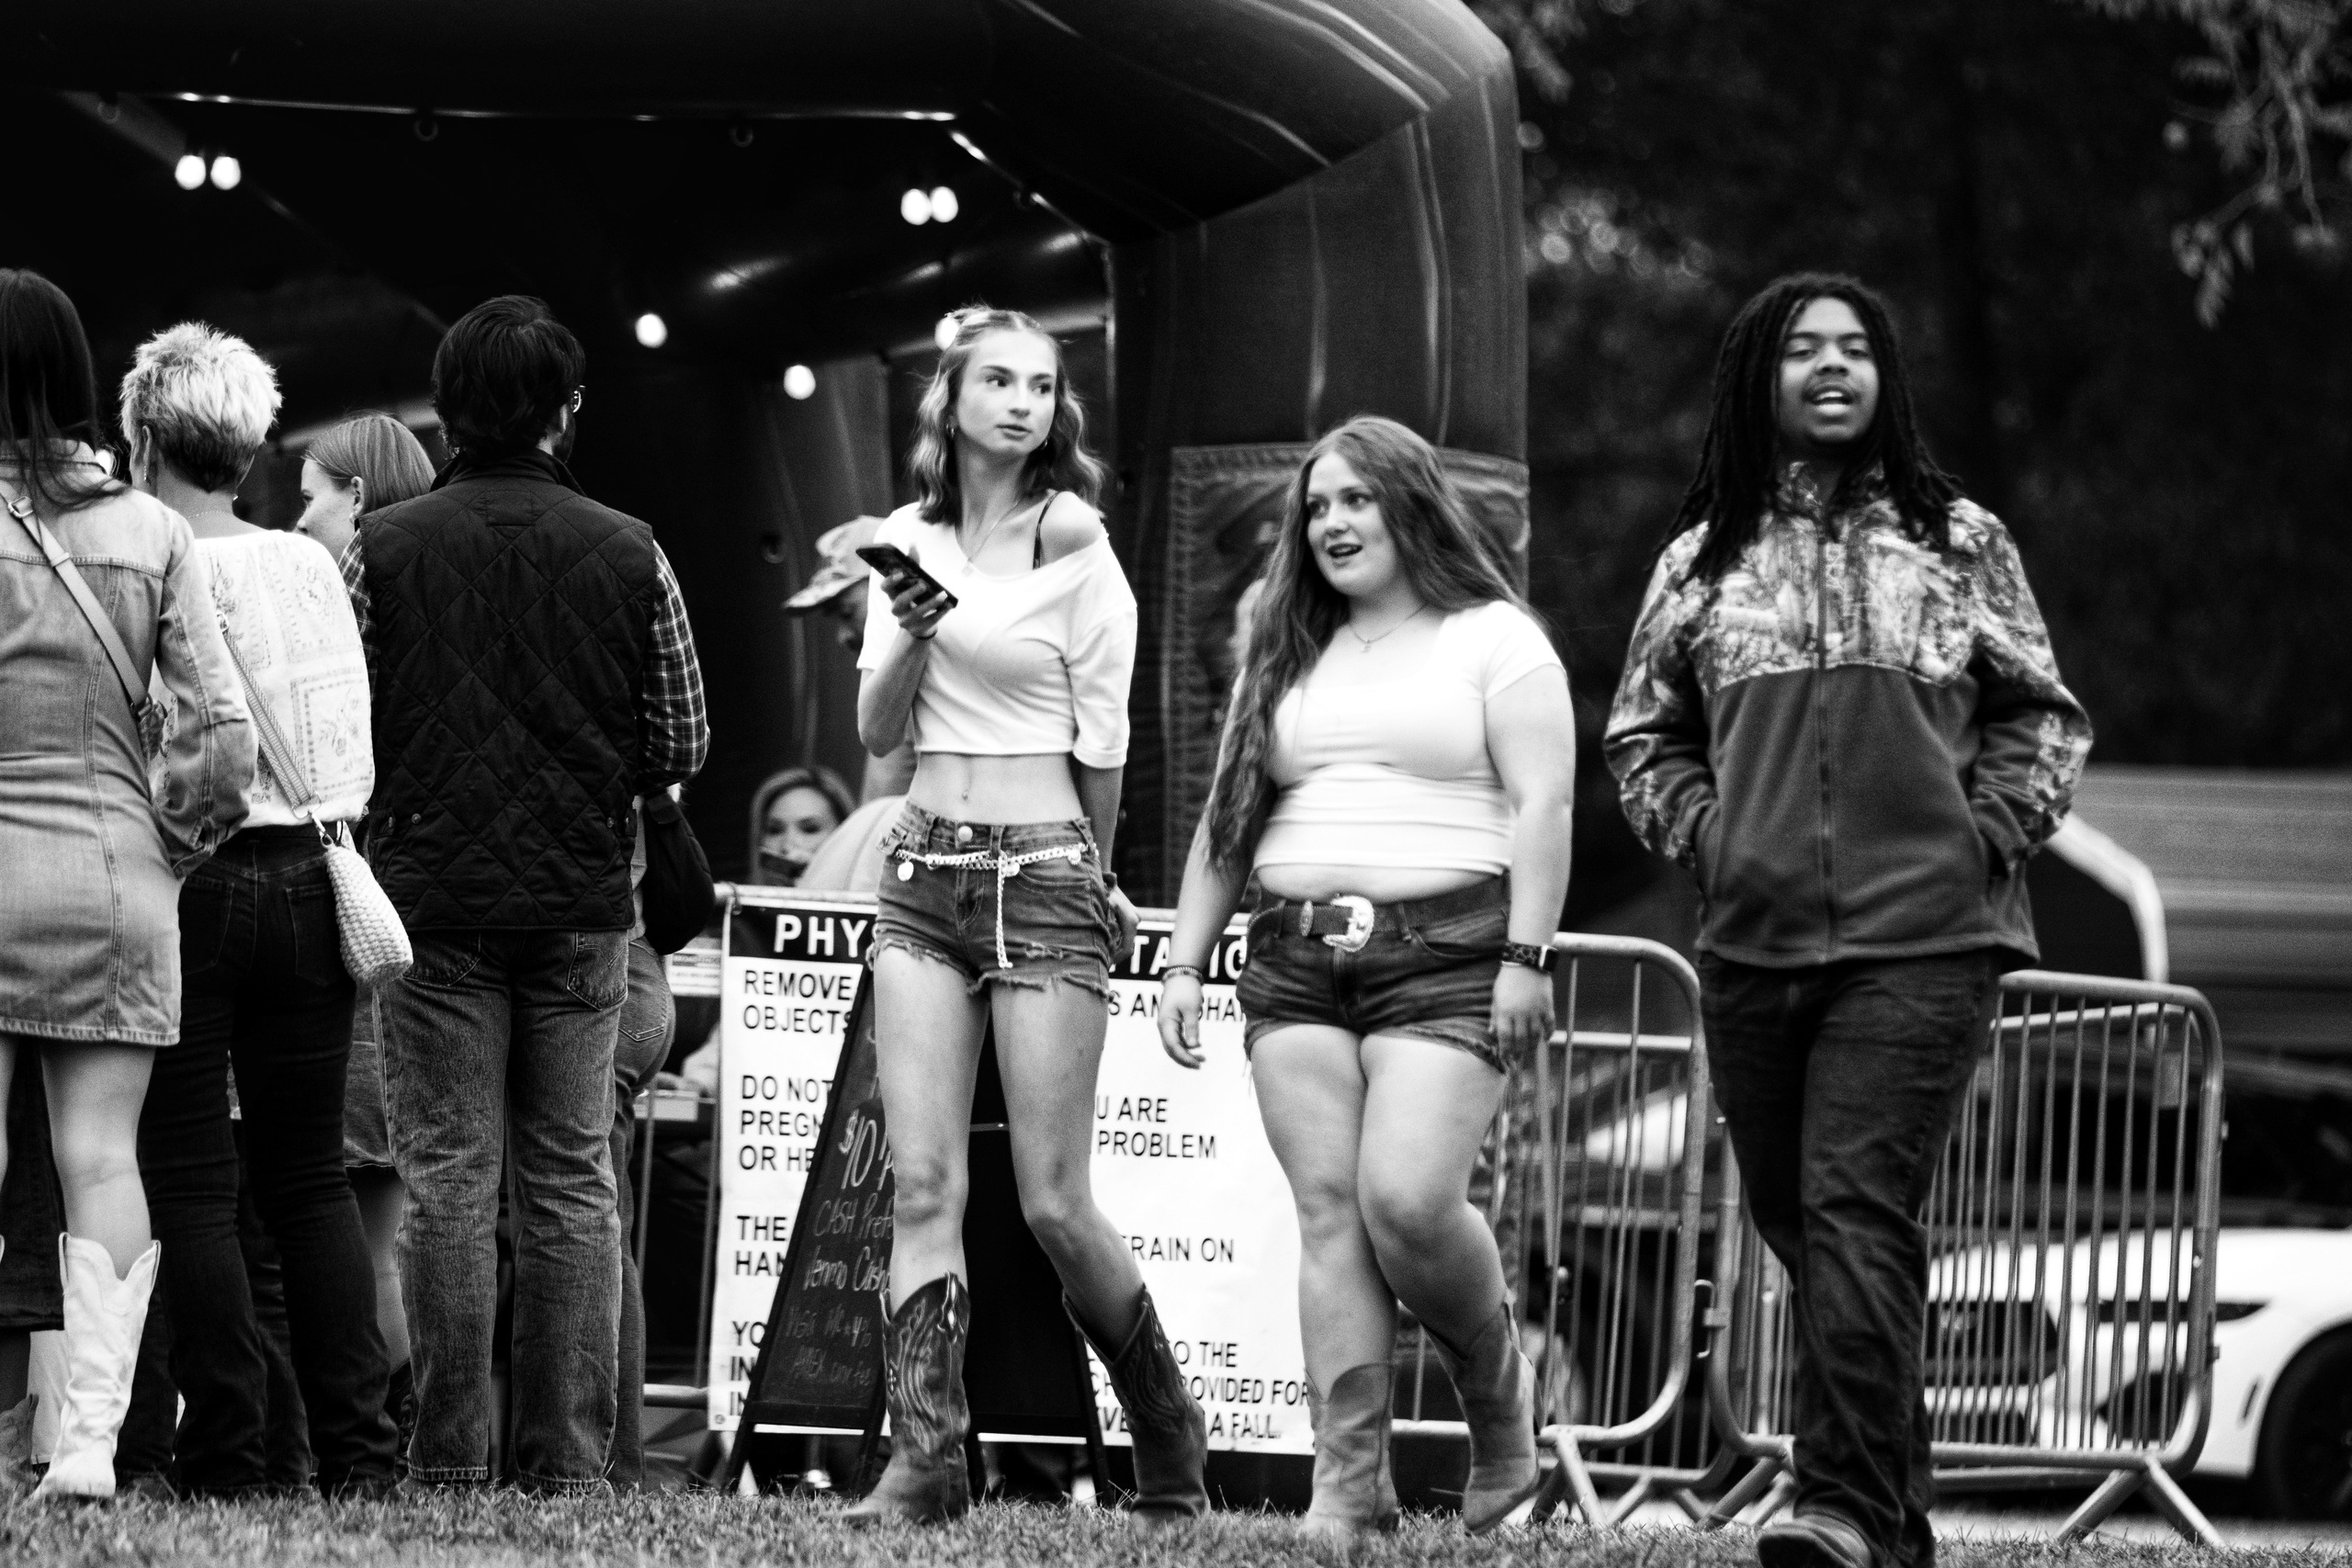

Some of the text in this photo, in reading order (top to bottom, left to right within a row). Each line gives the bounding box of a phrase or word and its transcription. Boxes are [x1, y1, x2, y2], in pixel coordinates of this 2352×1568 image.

[774, 914, 868, 958] PHY
[744, 969, 853, 1001] REMOVE
[741, 1075, 778, 1100] DO
[787, 1077, 834, 1102] NOT
[1117, 1097, 1169, 1122] ARE
[740, 1145, 777, 1171] OR
[1098, 1130, 1217, 1159] PROBLEM
[736, 1215, 1234, 1263] THE RAIN ON
[1199, 1341, 1238, 1368] THE
[1208, 1412, 1224, 1438] A
